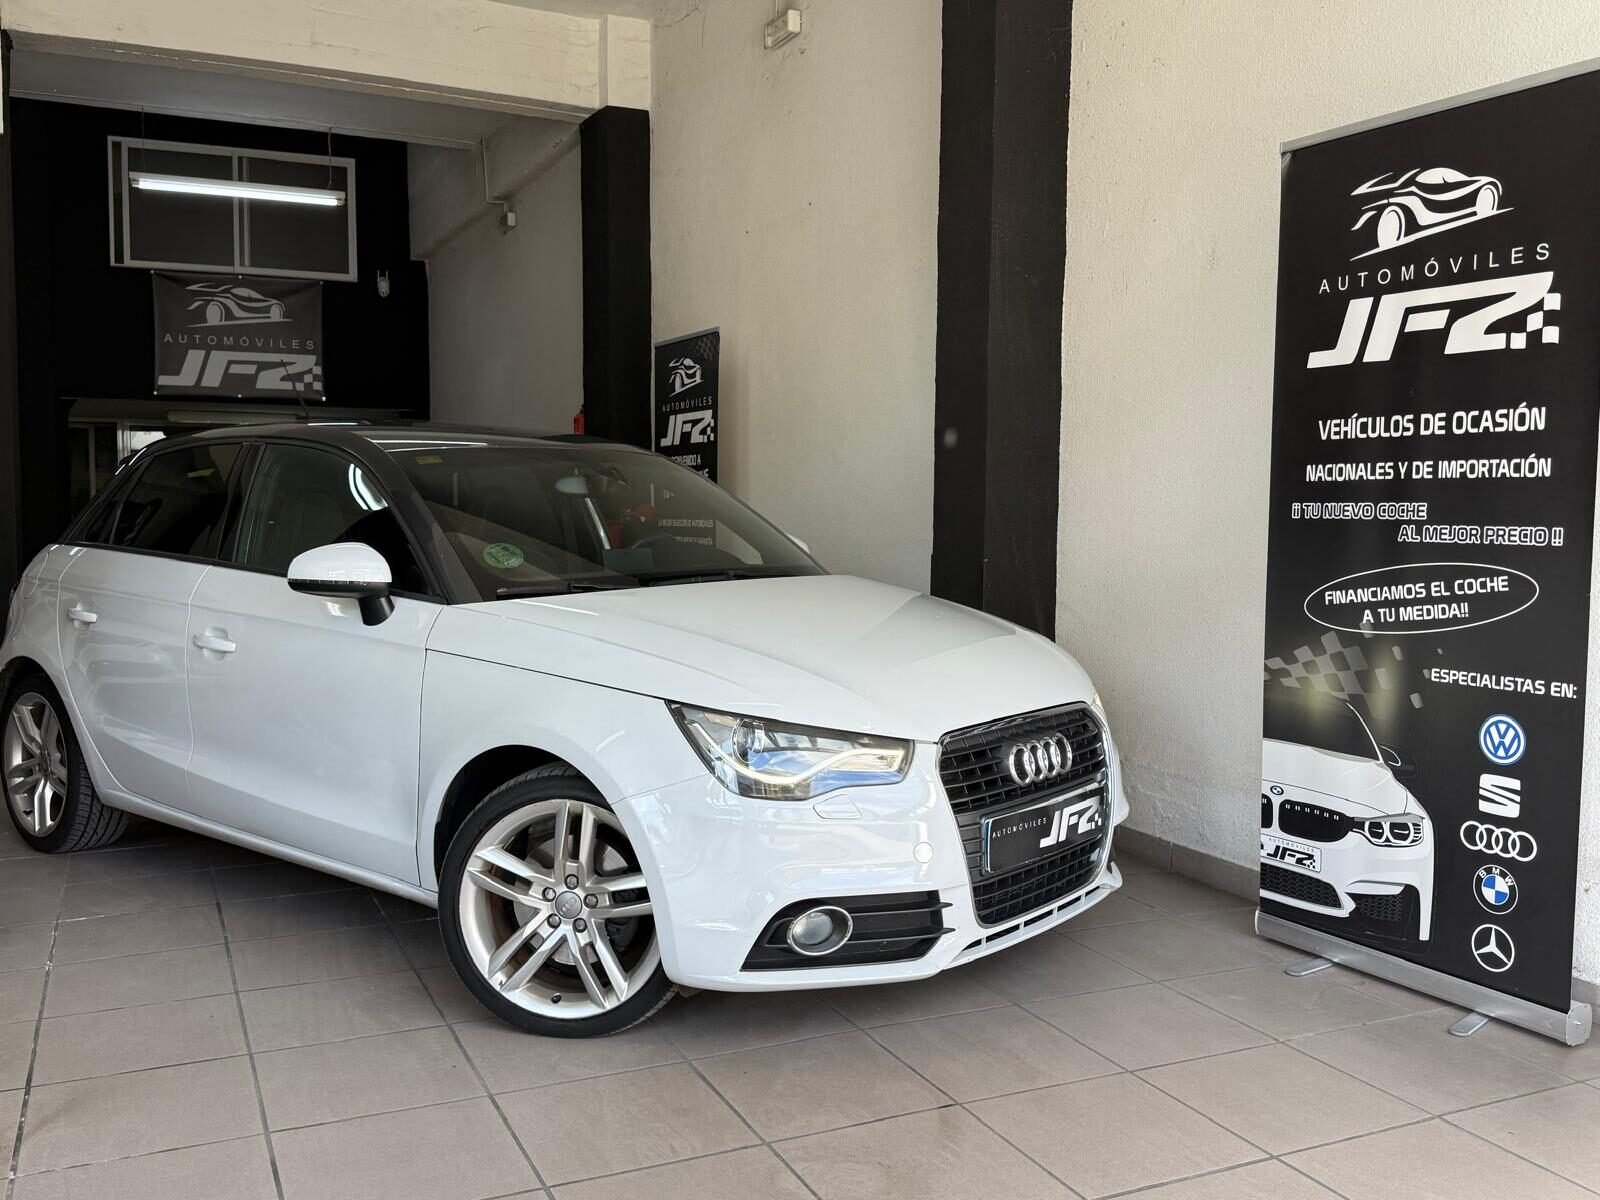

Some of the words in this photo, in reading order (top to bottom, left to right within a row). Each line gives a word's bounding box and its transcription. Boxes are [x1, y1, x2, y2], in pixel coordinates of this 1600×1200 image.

[1318, 243, 1550, 294] AUTOMÓVILES
[164, 333, 314, 350] AUTOMÓVILES
[1318, 412, 1414, 440] VEHÍCULOS
[1420, 412, 1446, 436] DE
[1452, 402, 1546, 434] OCASIÓN
[1306, 461, 1394, 482] NACIONALES
[1398, 462, 1408, 480] Y
[1412, 460, 1433, 479] DE
[1438, 453, 1551, 478] IMPORTACIÓN
[1303, 502, 1322, 519] TU
[1322, 502, 1374, 520] NUEVO
[1376, 502, 1427, 520] COCHE
[1398, 524, 1420, 542] AL
[1422, 525, 1480, 544] MEJOR
[1484, 526, 1548, 546] PRECIO
[1551, 527, 1564, 546] !!
[1324, 583, 1426, 606] FINANCIAMOS
[1431, 581, 1450, 597] EL
[1454, 576, 1509, 595] COCHE
[1362, 609, 1374, 624] A
[1378, 608, 1396, 622] TU
[1399, 602, 1468, 622] MEDIDA!!
[1430, 668, 1545, 695] ESPECIALISTAS
[1550, 682, 1578, 699] EN:
[1478, 867, 1514, 886] BMW
